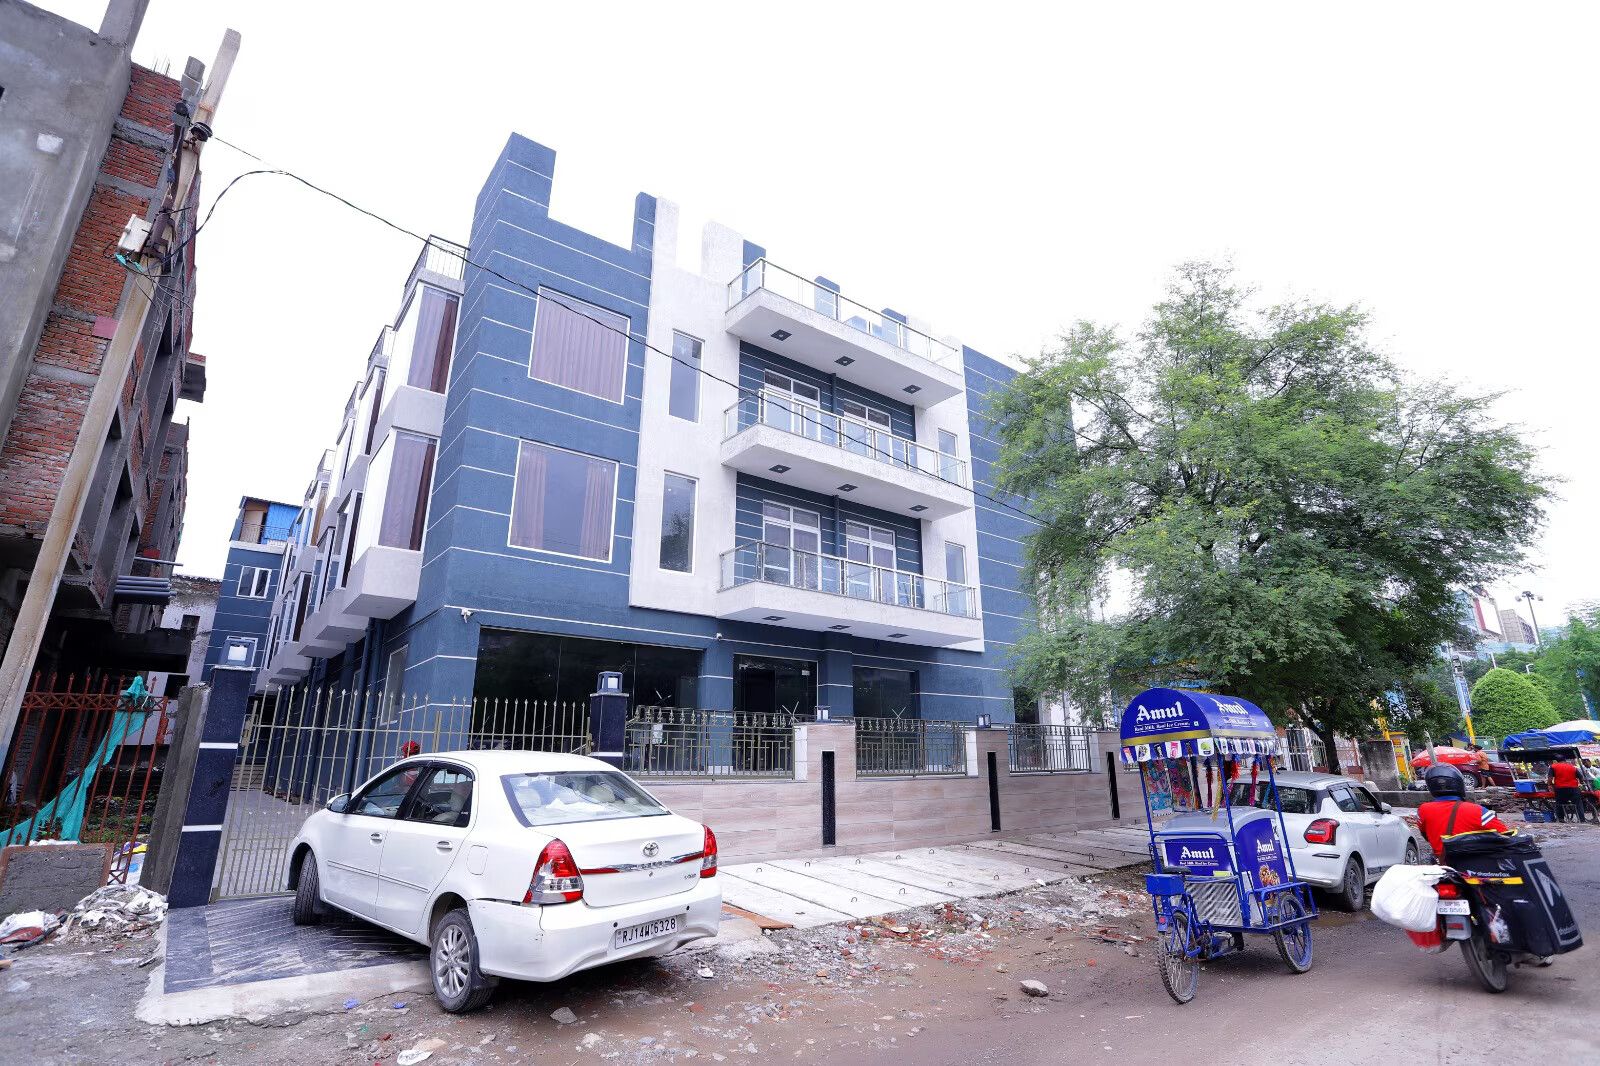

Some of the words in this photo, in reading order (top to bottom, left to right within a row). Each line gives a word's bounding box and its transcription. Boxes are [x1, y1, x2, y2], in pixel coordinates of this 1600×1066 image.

[1136, 701, 1184, 724] Amul
[1181, 846, 1215, 860] Amul
[1256, 838, 1275, 855] Amul
